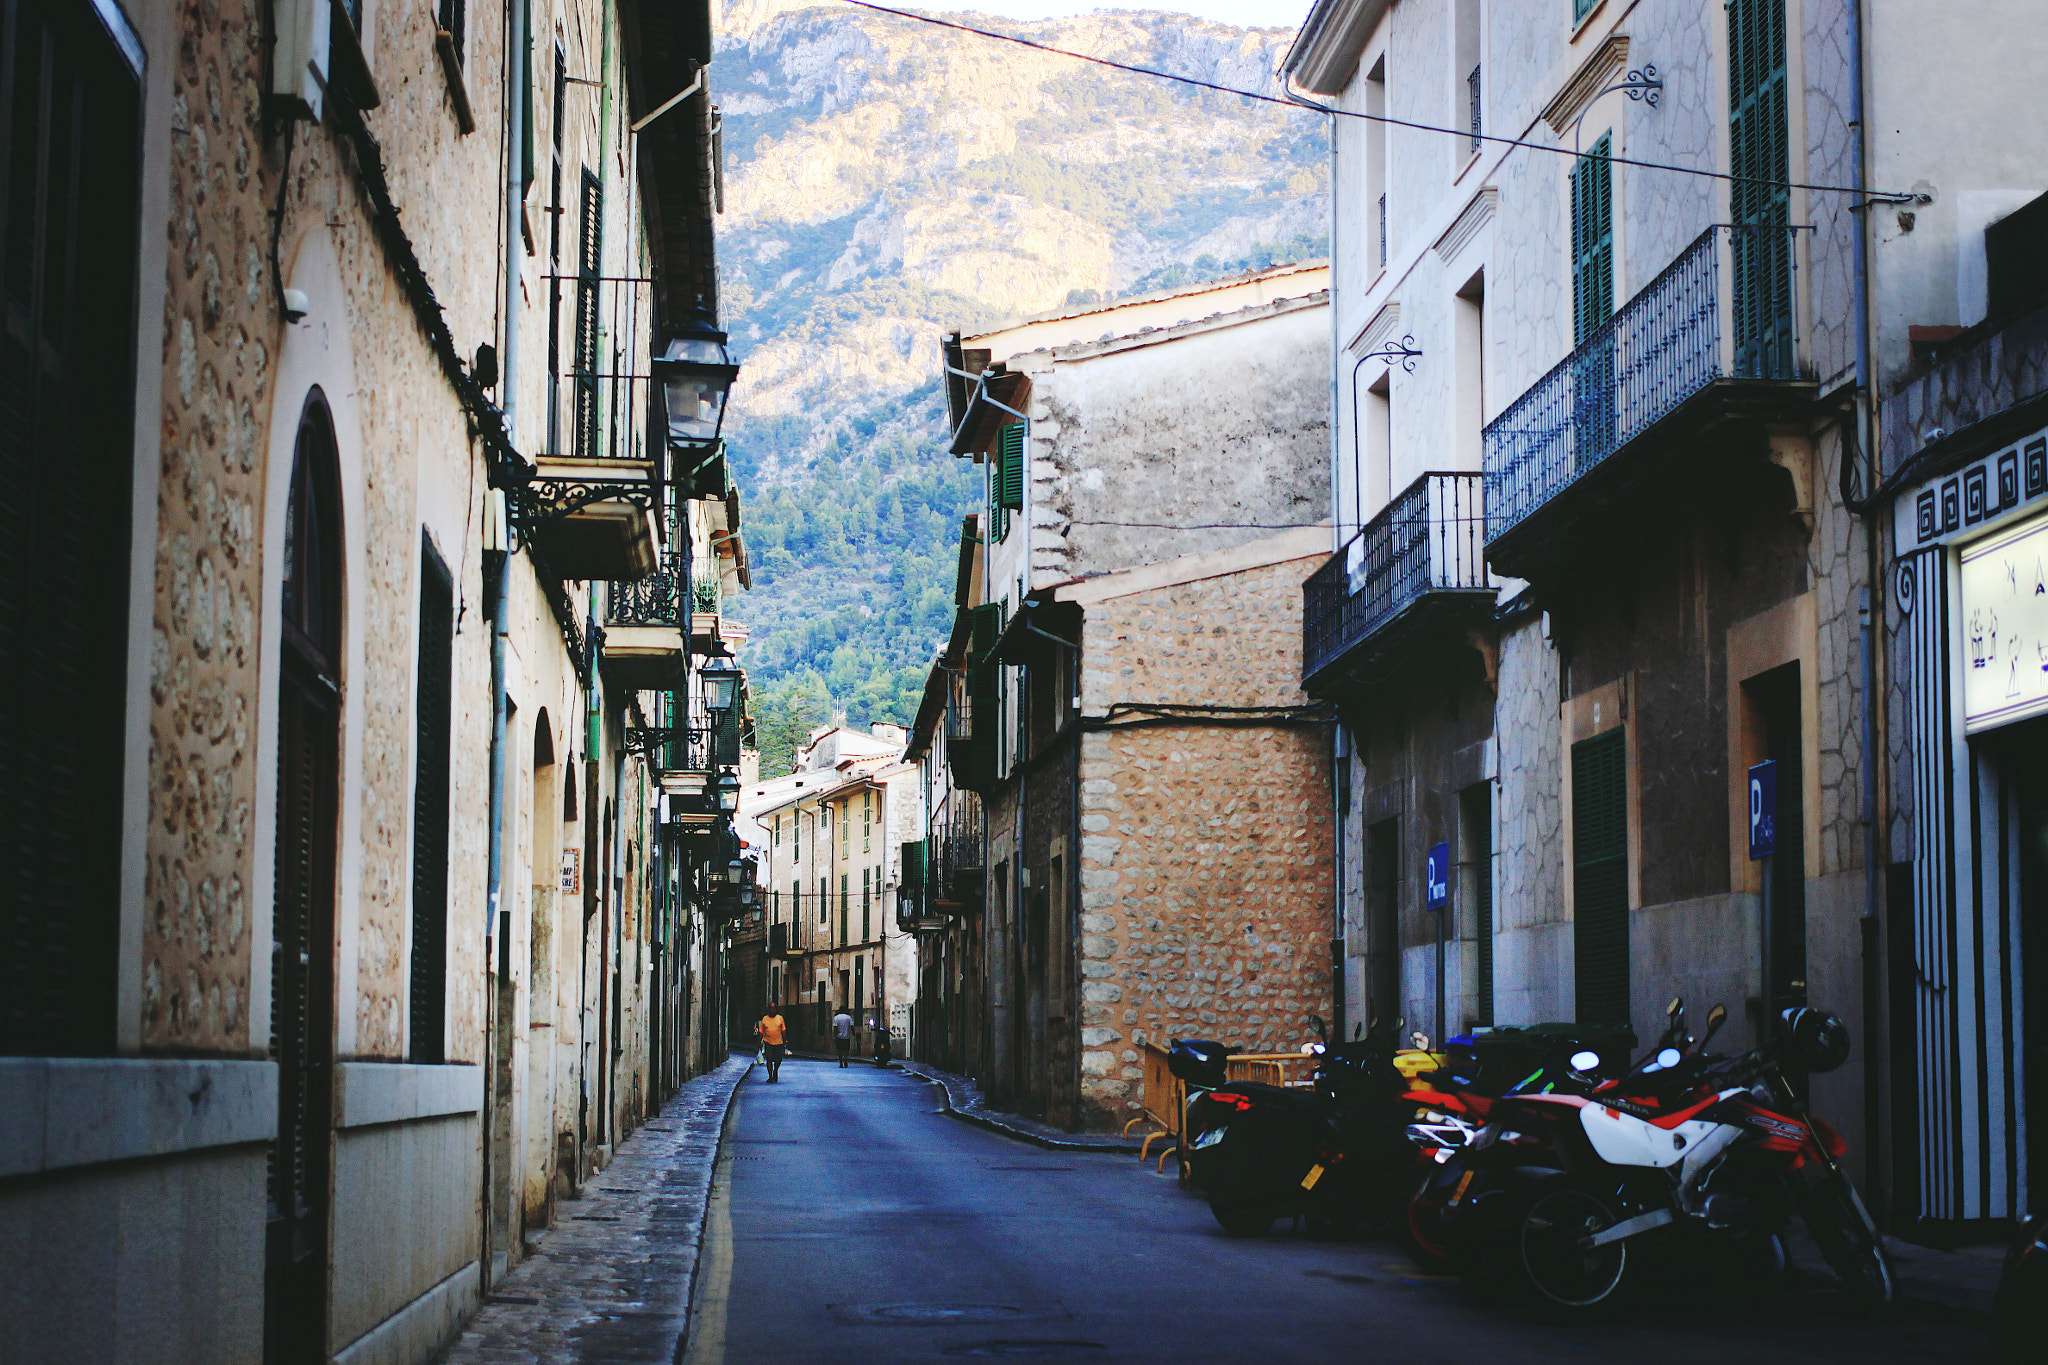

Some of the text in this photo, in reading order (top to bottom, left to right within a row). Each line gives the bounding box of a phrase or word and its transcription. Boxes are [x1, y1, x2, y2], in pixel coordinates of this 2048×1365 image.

[1750, 778, 1762, 846] P
[1428, 857, 1435, 902] P
[1601, 1098, 1650, 1115] HONDA
